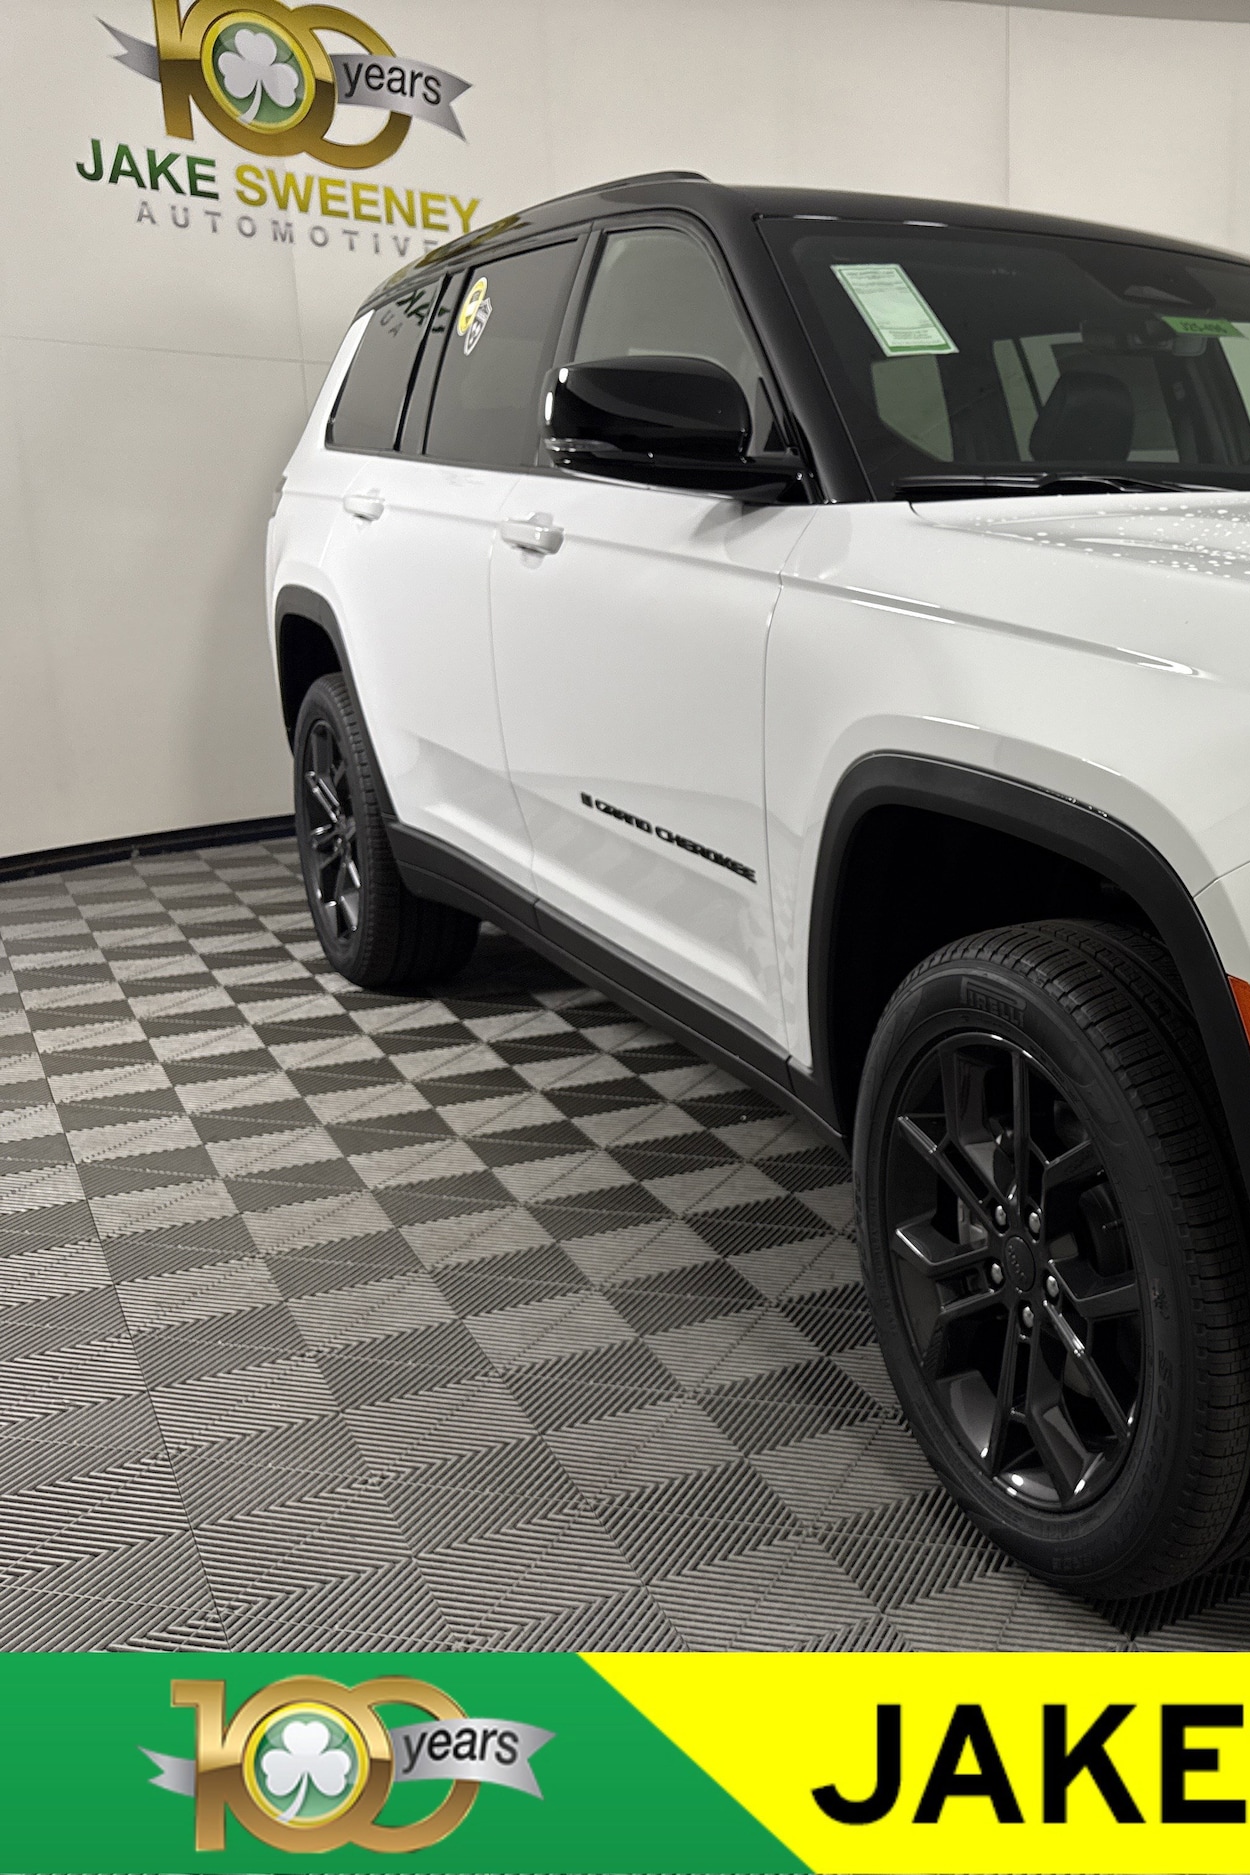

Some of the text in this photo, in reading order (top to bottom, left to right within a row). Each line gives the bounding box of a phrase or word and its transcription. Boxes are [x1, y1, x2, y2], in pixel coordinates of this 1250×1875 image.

[343, 57, 441, 105] years
[76, 138, 482, 234] JAKE SWEENEY
[595, 799, 757, 884] GRAND CHEROKEE
[960, 976, 1027, 1028] PIRELLI
